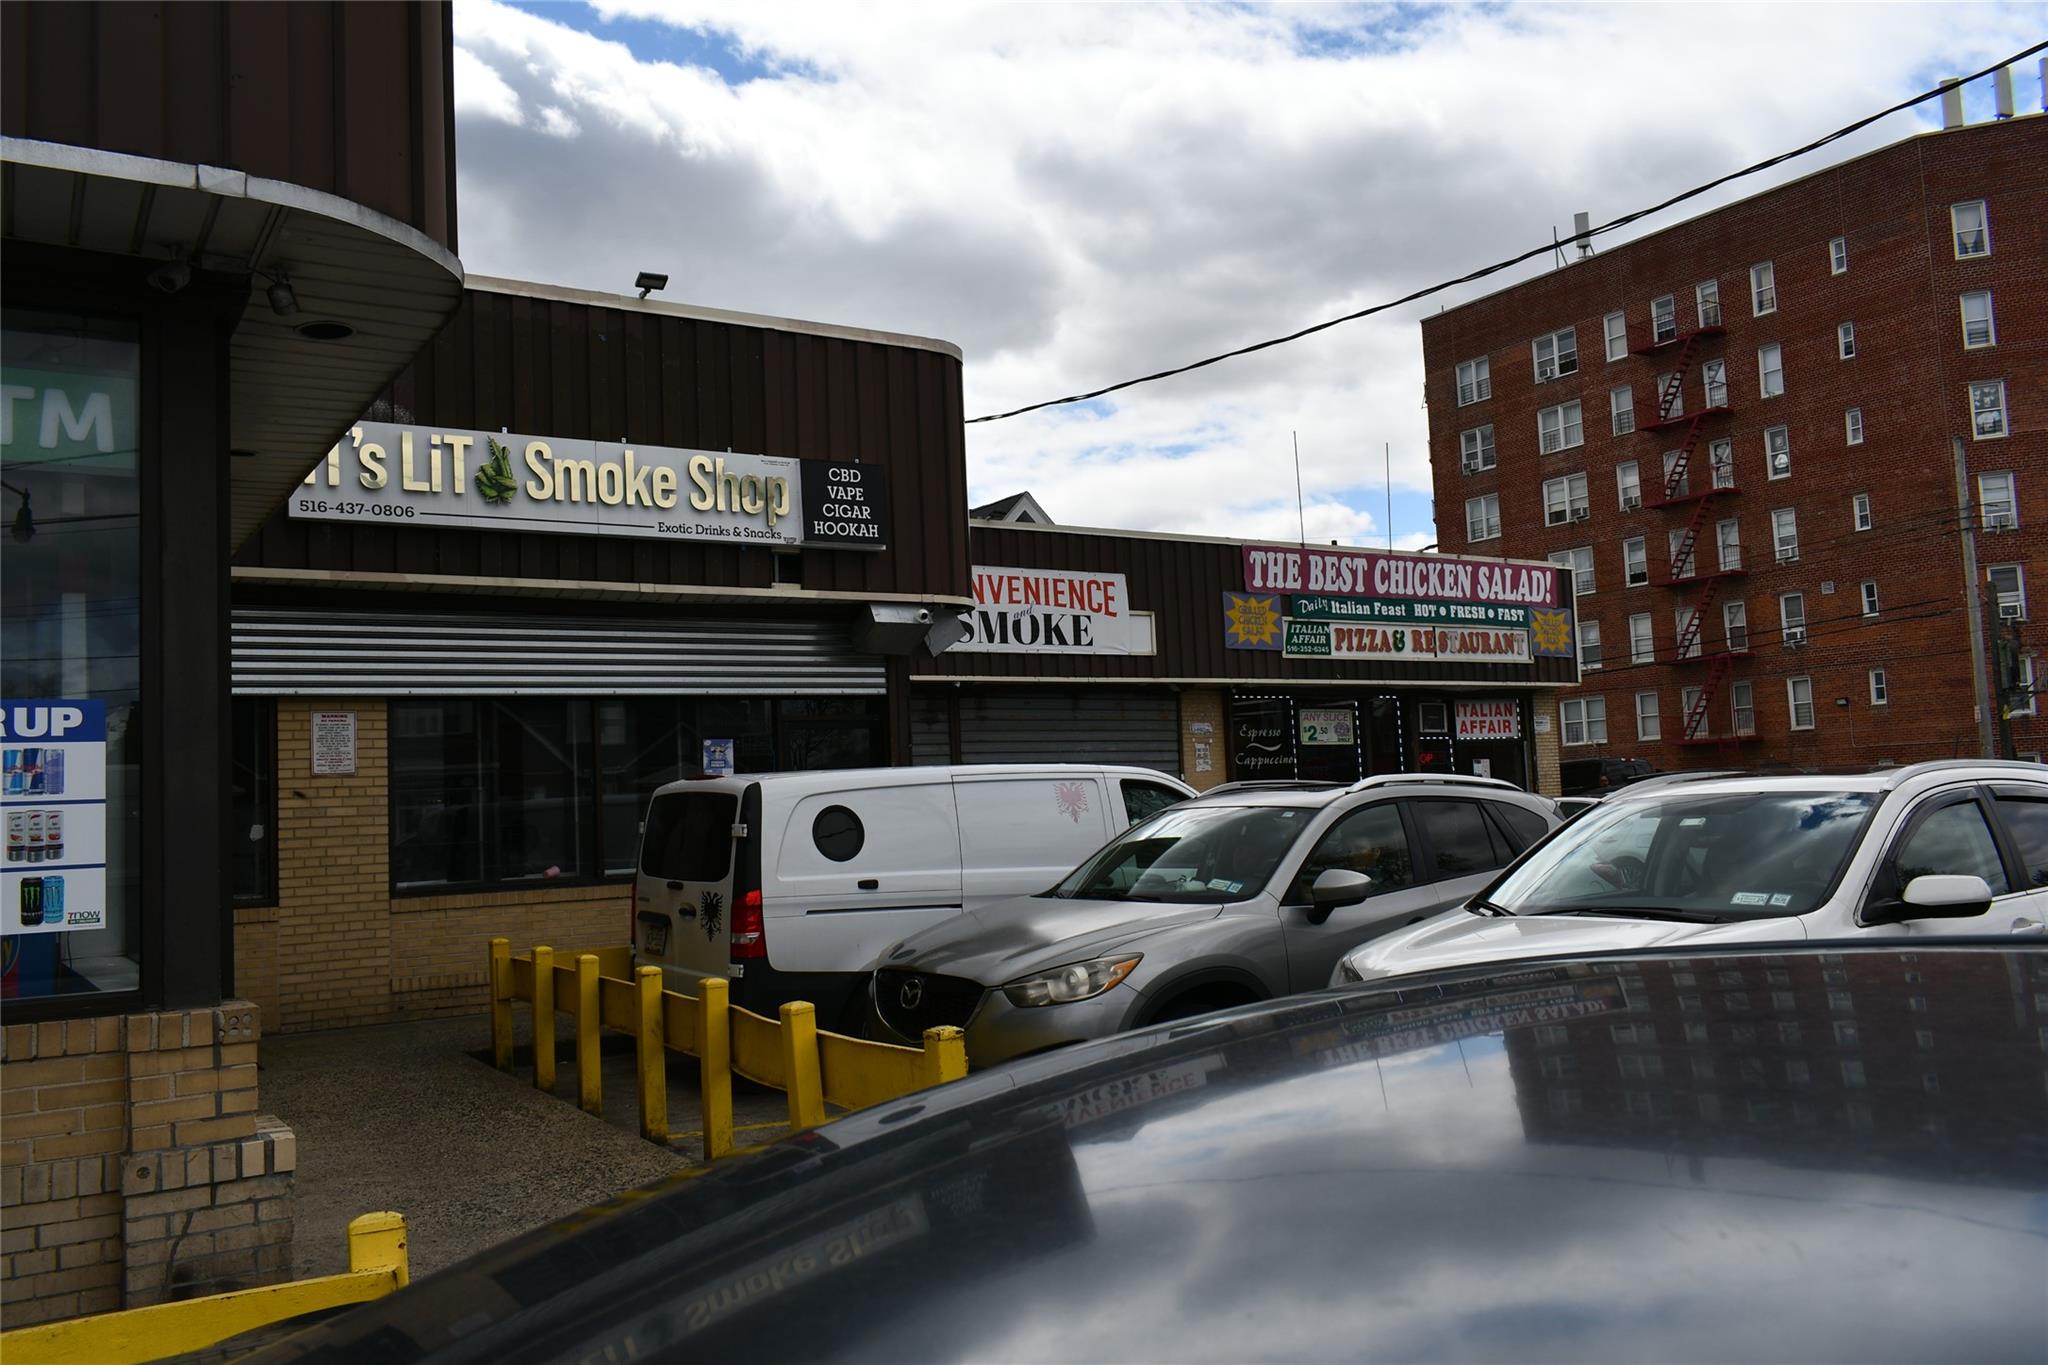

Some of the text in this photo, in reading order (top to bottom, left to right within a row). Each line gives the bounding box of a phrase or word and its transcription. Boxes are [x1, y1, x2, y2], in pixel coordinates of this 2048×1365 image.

[402, 431, 473, 494] LiT
[525, 441, 677, 509] Smoke
[689, 455, 790, 527] Shop
[828, 468, 862, 483] CBD
[827, 485, 864, 501] VAPE
[299, 500, 415, 518] 516-437-0806
[822, 503, 871, 520] CIGAR
[658, 522, 782, 540] Exotic Drinks & Snacks
[813, 520, 879, 538] HOOKAH
[1249, 551, 1552, 604] THE BEST CHICKEN SALAD!
[1013, 601, 1034, 620] and
[1297, 597, 1525, 621] Daily Italian Feast HOT FRESH FAST
[956, 610, 1094, 647] SMOKE
[1290, 624, 1330, 634] ITALIAN
[1291, 634, 1327, 644] AFFAIR
[1333, 627, 1392, 653] PIZZA
[1392, 629, 1406, 653] &
[1411, 629, 1525, 656] RESTAURANT
[1322, 712, 1349, 722] SLICE
[1455, 703, 1513, 717] ITALIAN
[0, 707, 83, 737] UP
[1459, 719, 1513, 735] AFFAIR
[1239, 724, 1282, 741] Espresso
[1235, 753, 1294, 769] Cappuccino
